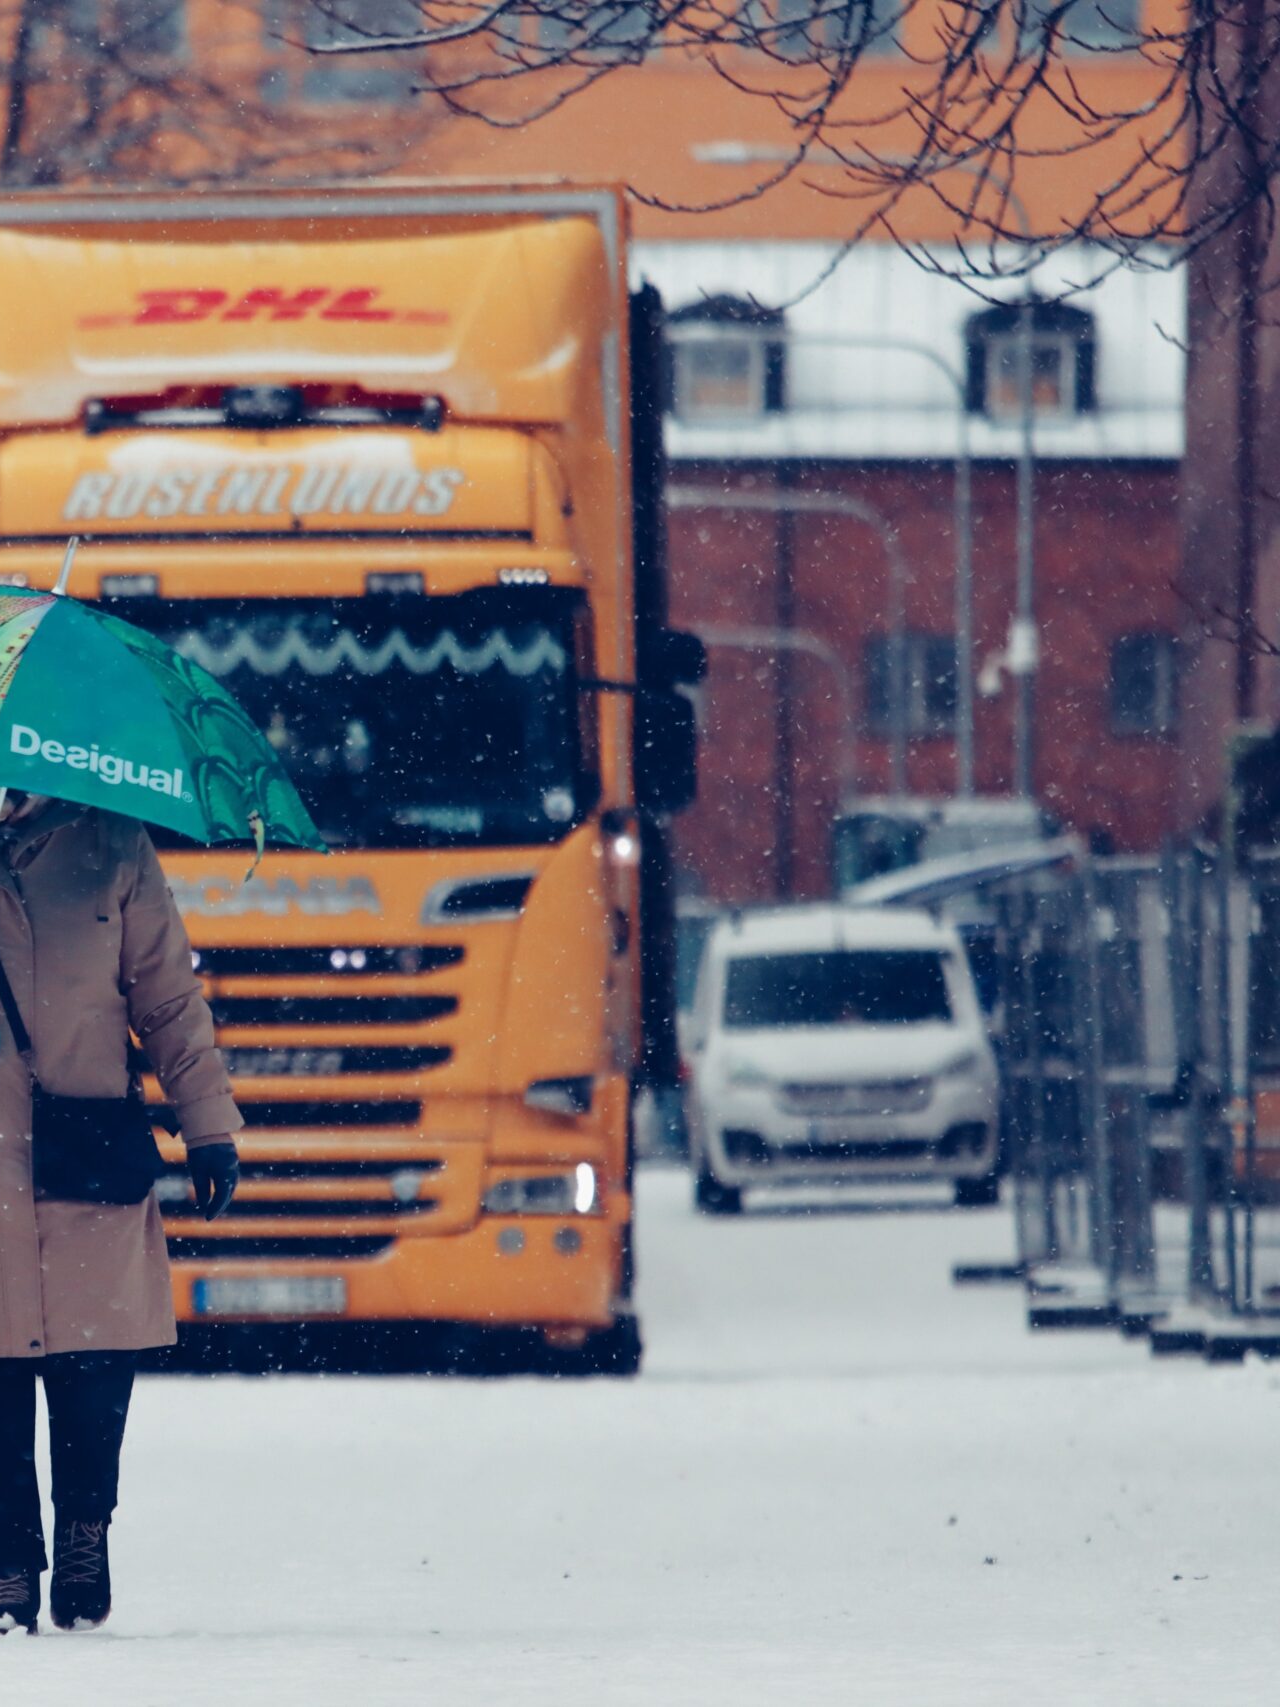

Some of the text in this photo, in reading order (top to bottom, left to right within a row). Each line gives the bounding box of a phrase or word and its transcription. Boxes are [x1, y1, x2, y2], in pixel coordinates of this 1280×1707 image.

[134, 287, 395, 325] DHL
[62, 466, 464, 520] ROSENLUNDS
[10, 723, 183, 798] Desigual
